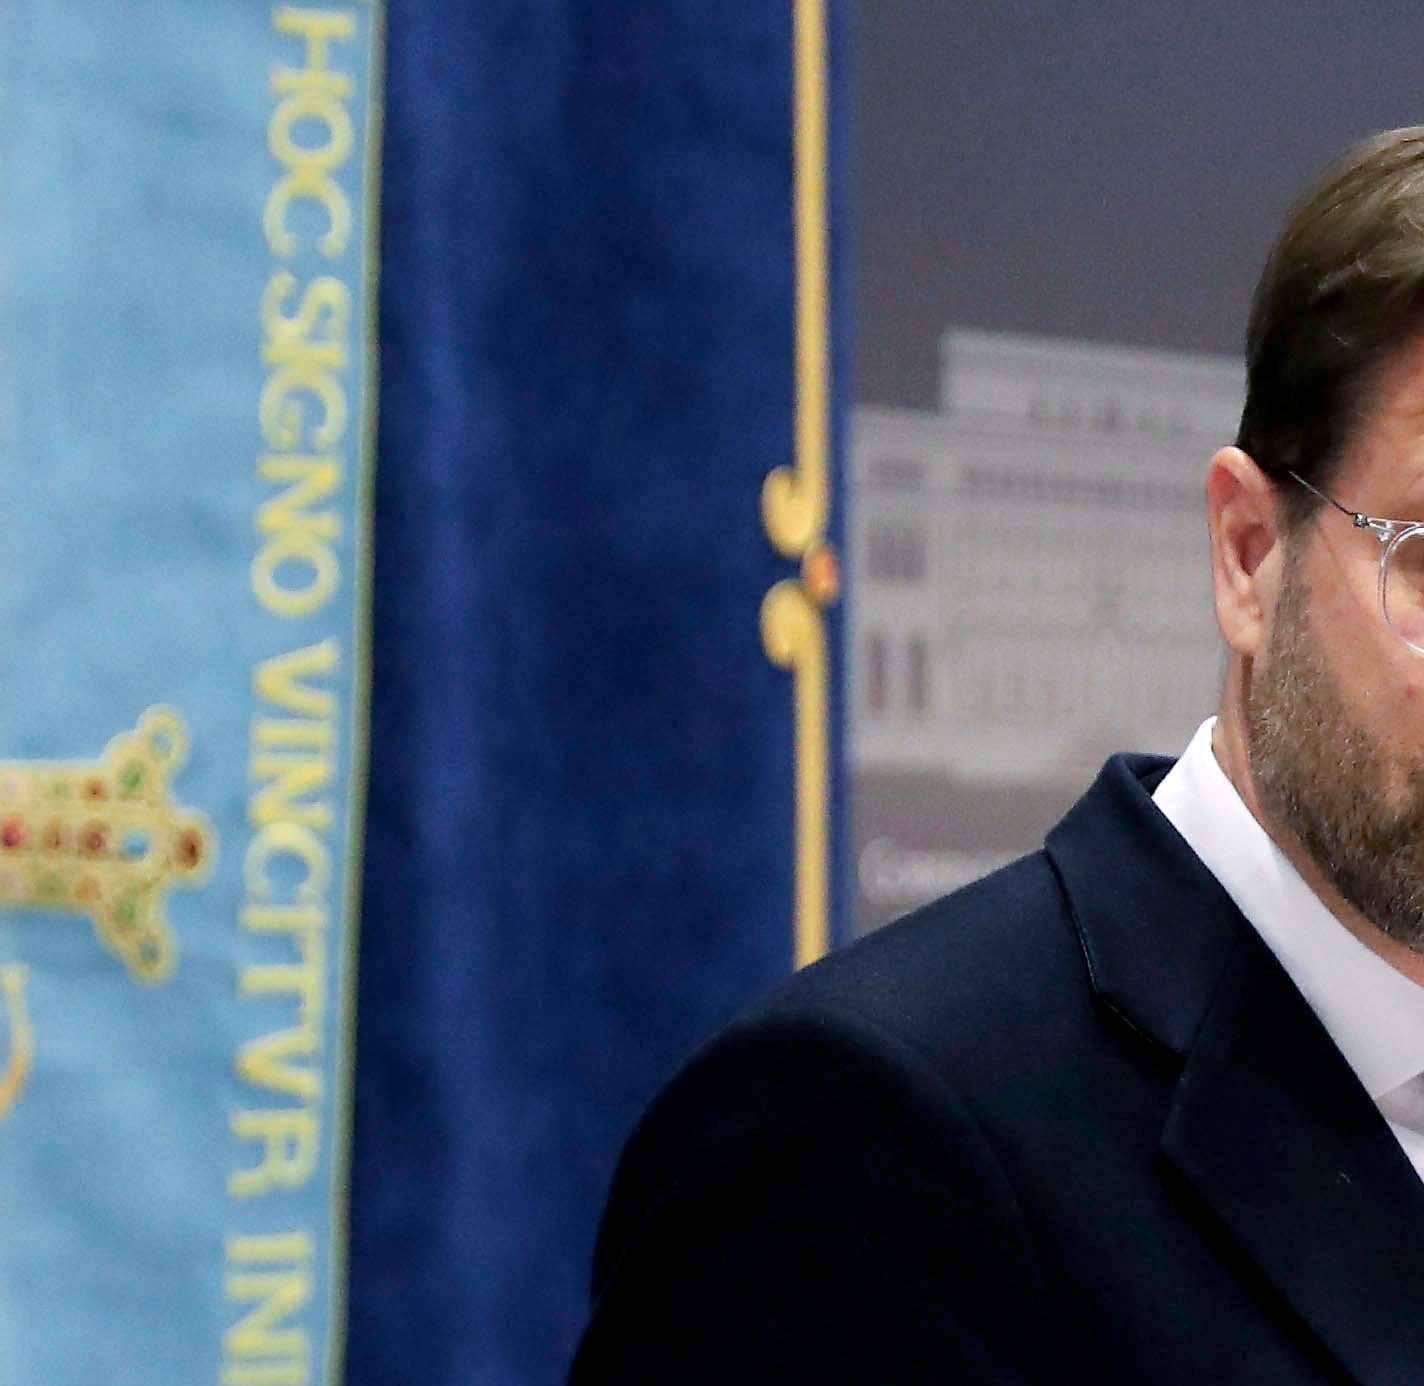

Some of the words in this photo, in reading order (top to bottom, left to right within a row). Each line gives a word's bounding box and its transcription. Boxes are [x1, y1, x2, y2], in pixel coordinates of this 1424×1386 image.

[264, 8, 356, 259] HOC
[252, 270, 350, 619] SIGNO
[228, 638, 341, 1200] VINCITVR
